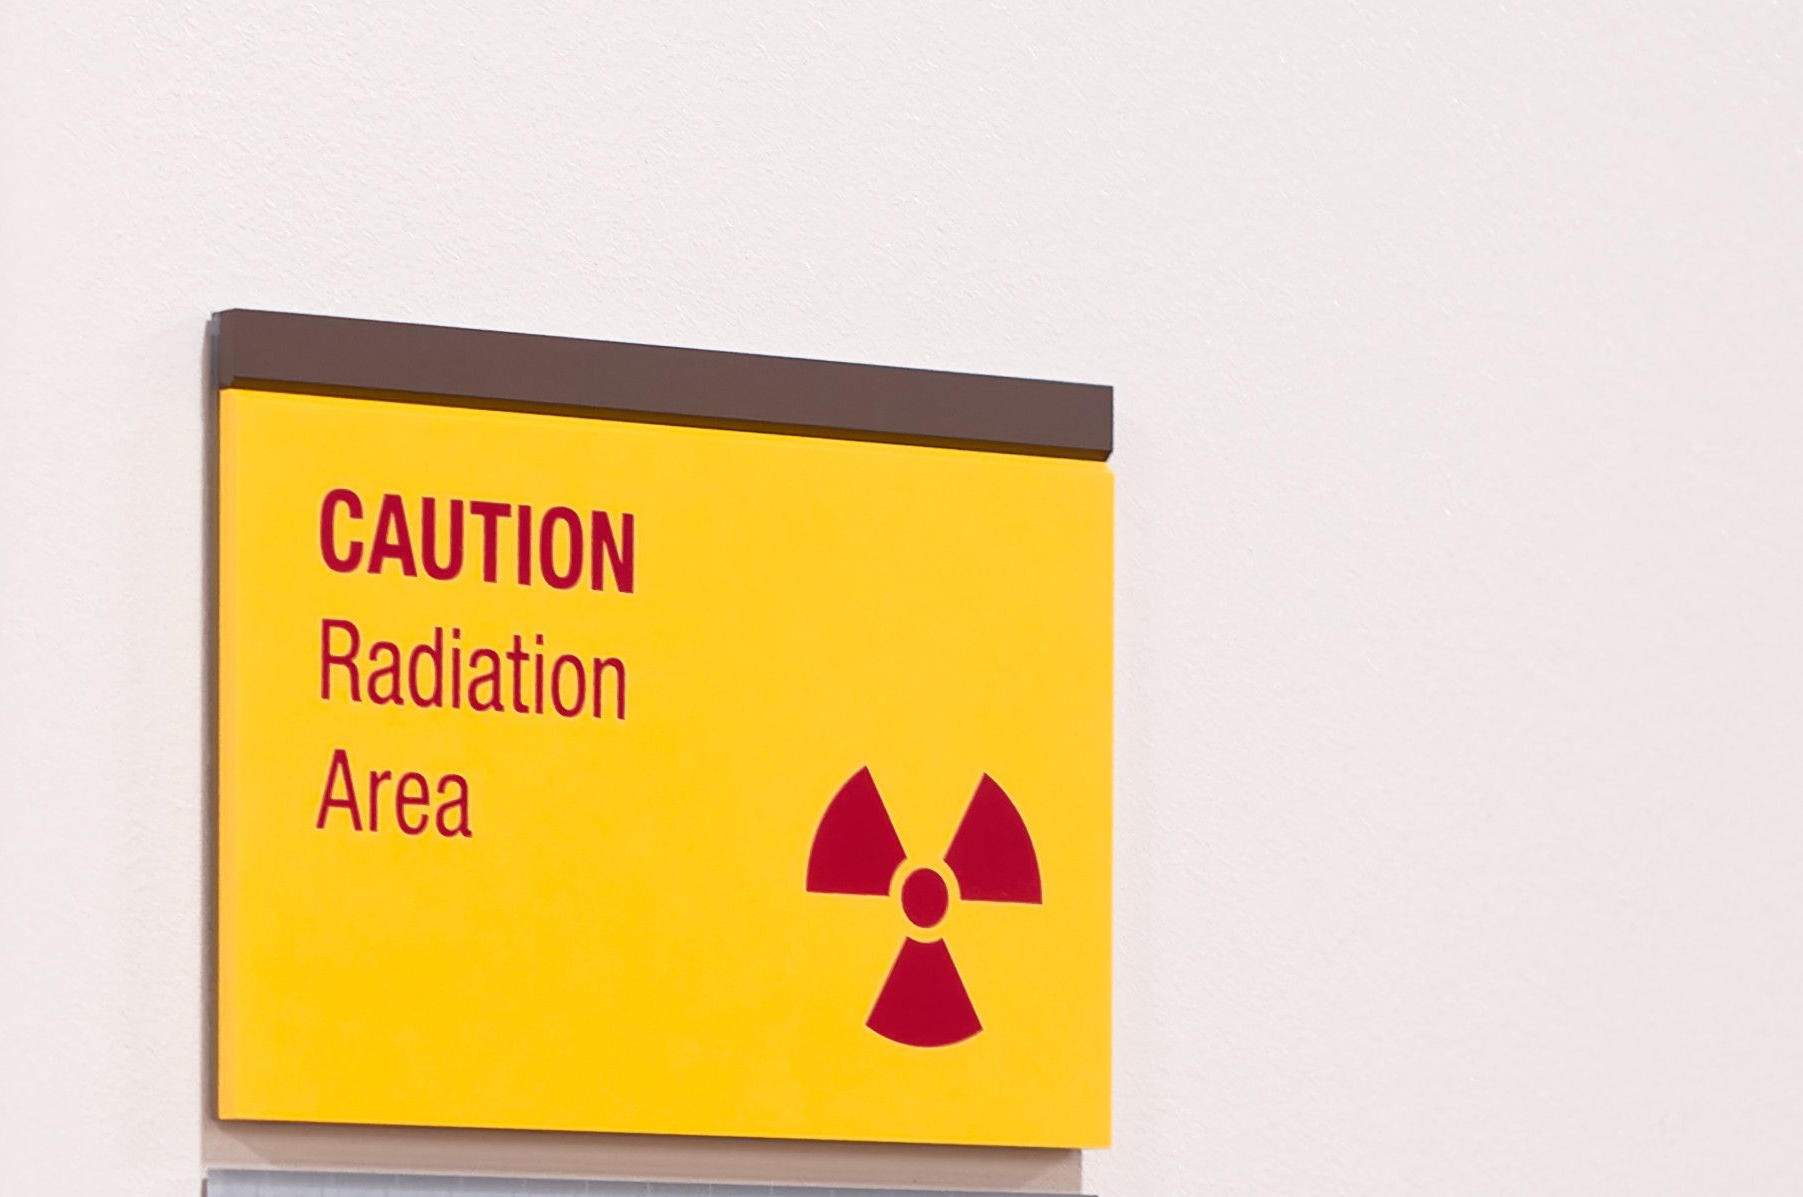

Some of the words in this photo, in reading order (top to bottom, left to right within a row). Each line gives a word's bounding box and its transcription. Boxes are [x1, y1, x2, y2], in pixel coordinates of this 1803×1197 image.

[319, 488, 636, 595] CAUTION
[319, 618, 627, 721] Radiation
[315, 748, 474, 838] Area
